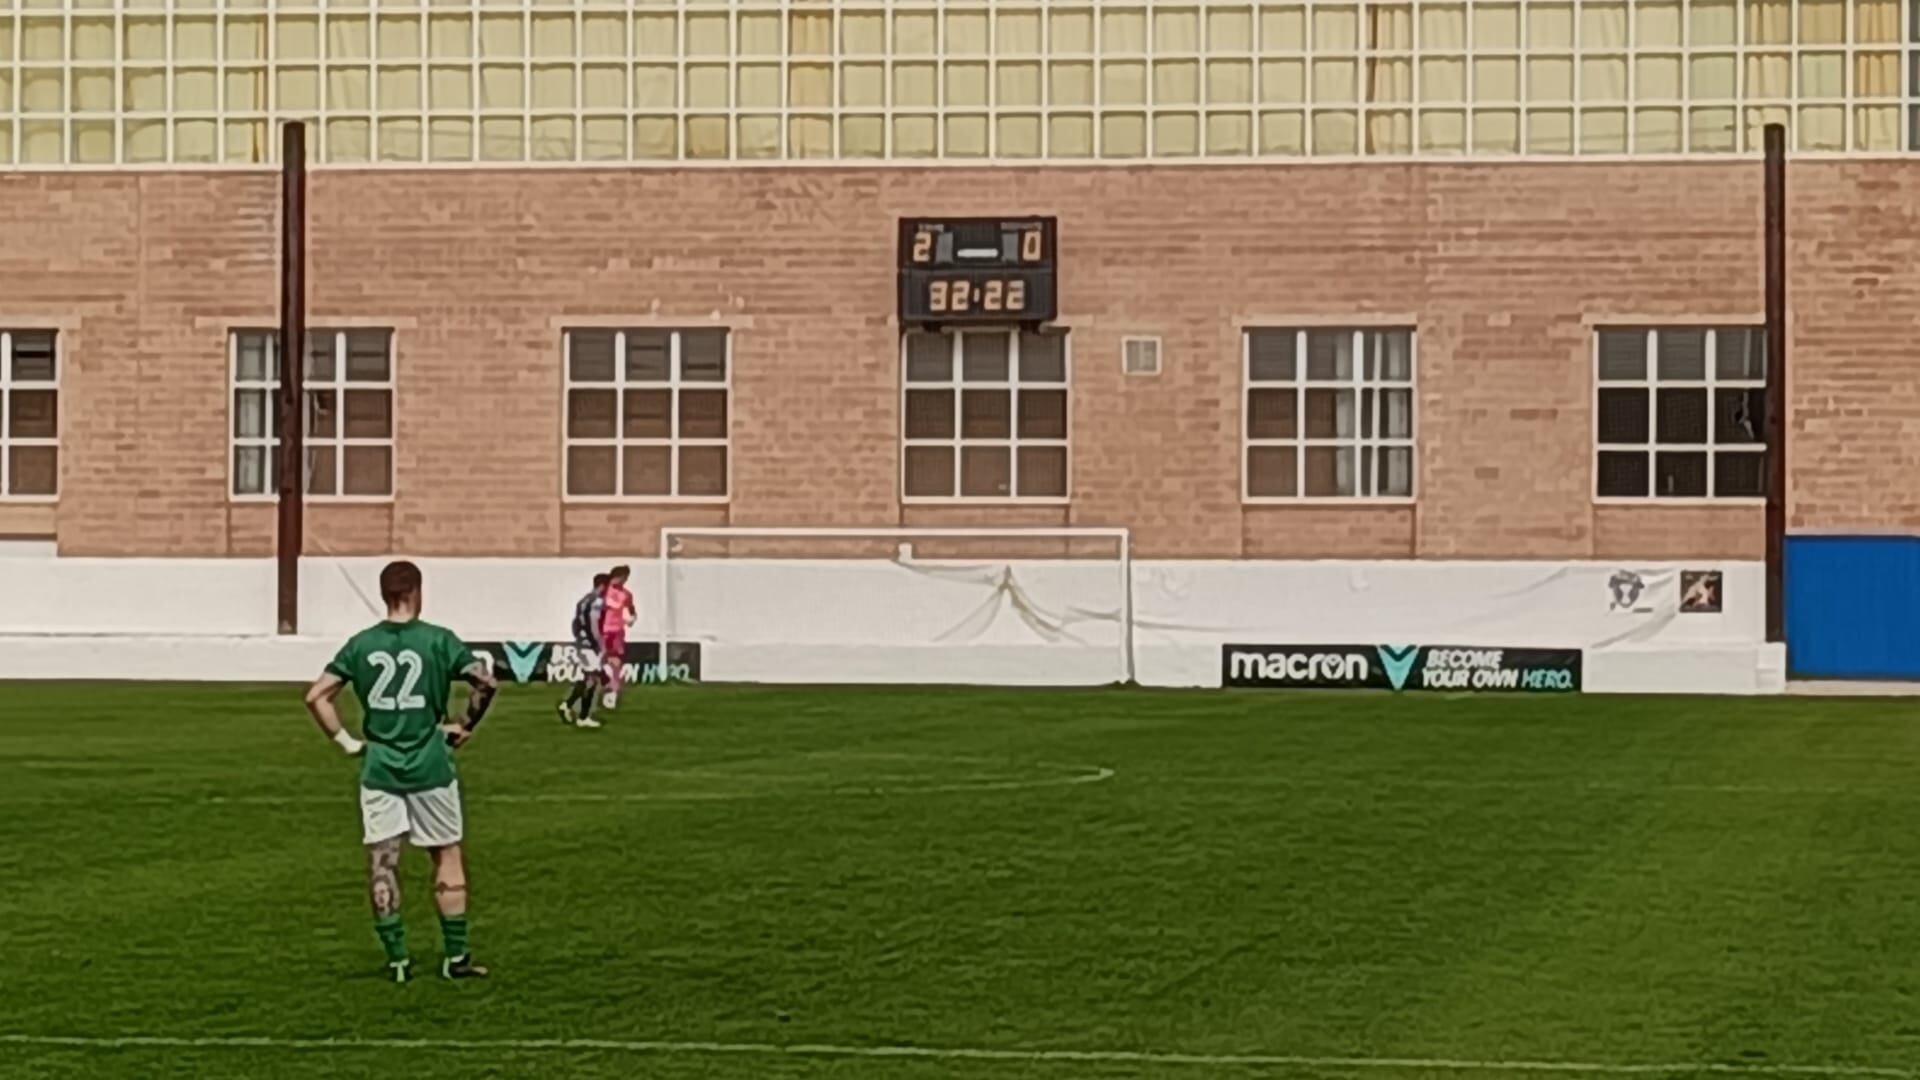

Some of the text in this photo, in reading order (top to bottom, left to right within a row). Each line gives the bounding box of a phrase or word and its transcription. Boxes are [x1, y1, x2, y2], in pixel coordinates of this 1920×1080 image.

[913, 232, 931, 262] 2
[1022, 231, 1041, 261] 0
[930, 280, 1025, 311] 32:22
[1230, 652, 1368, 681] macron
[1426, 649, 1504, 669] BECOME
[367, 649, 426, 710] 22
[1422, 668, 1470, 688] YOUR
[1472, 669, 1519, 688] OWN
